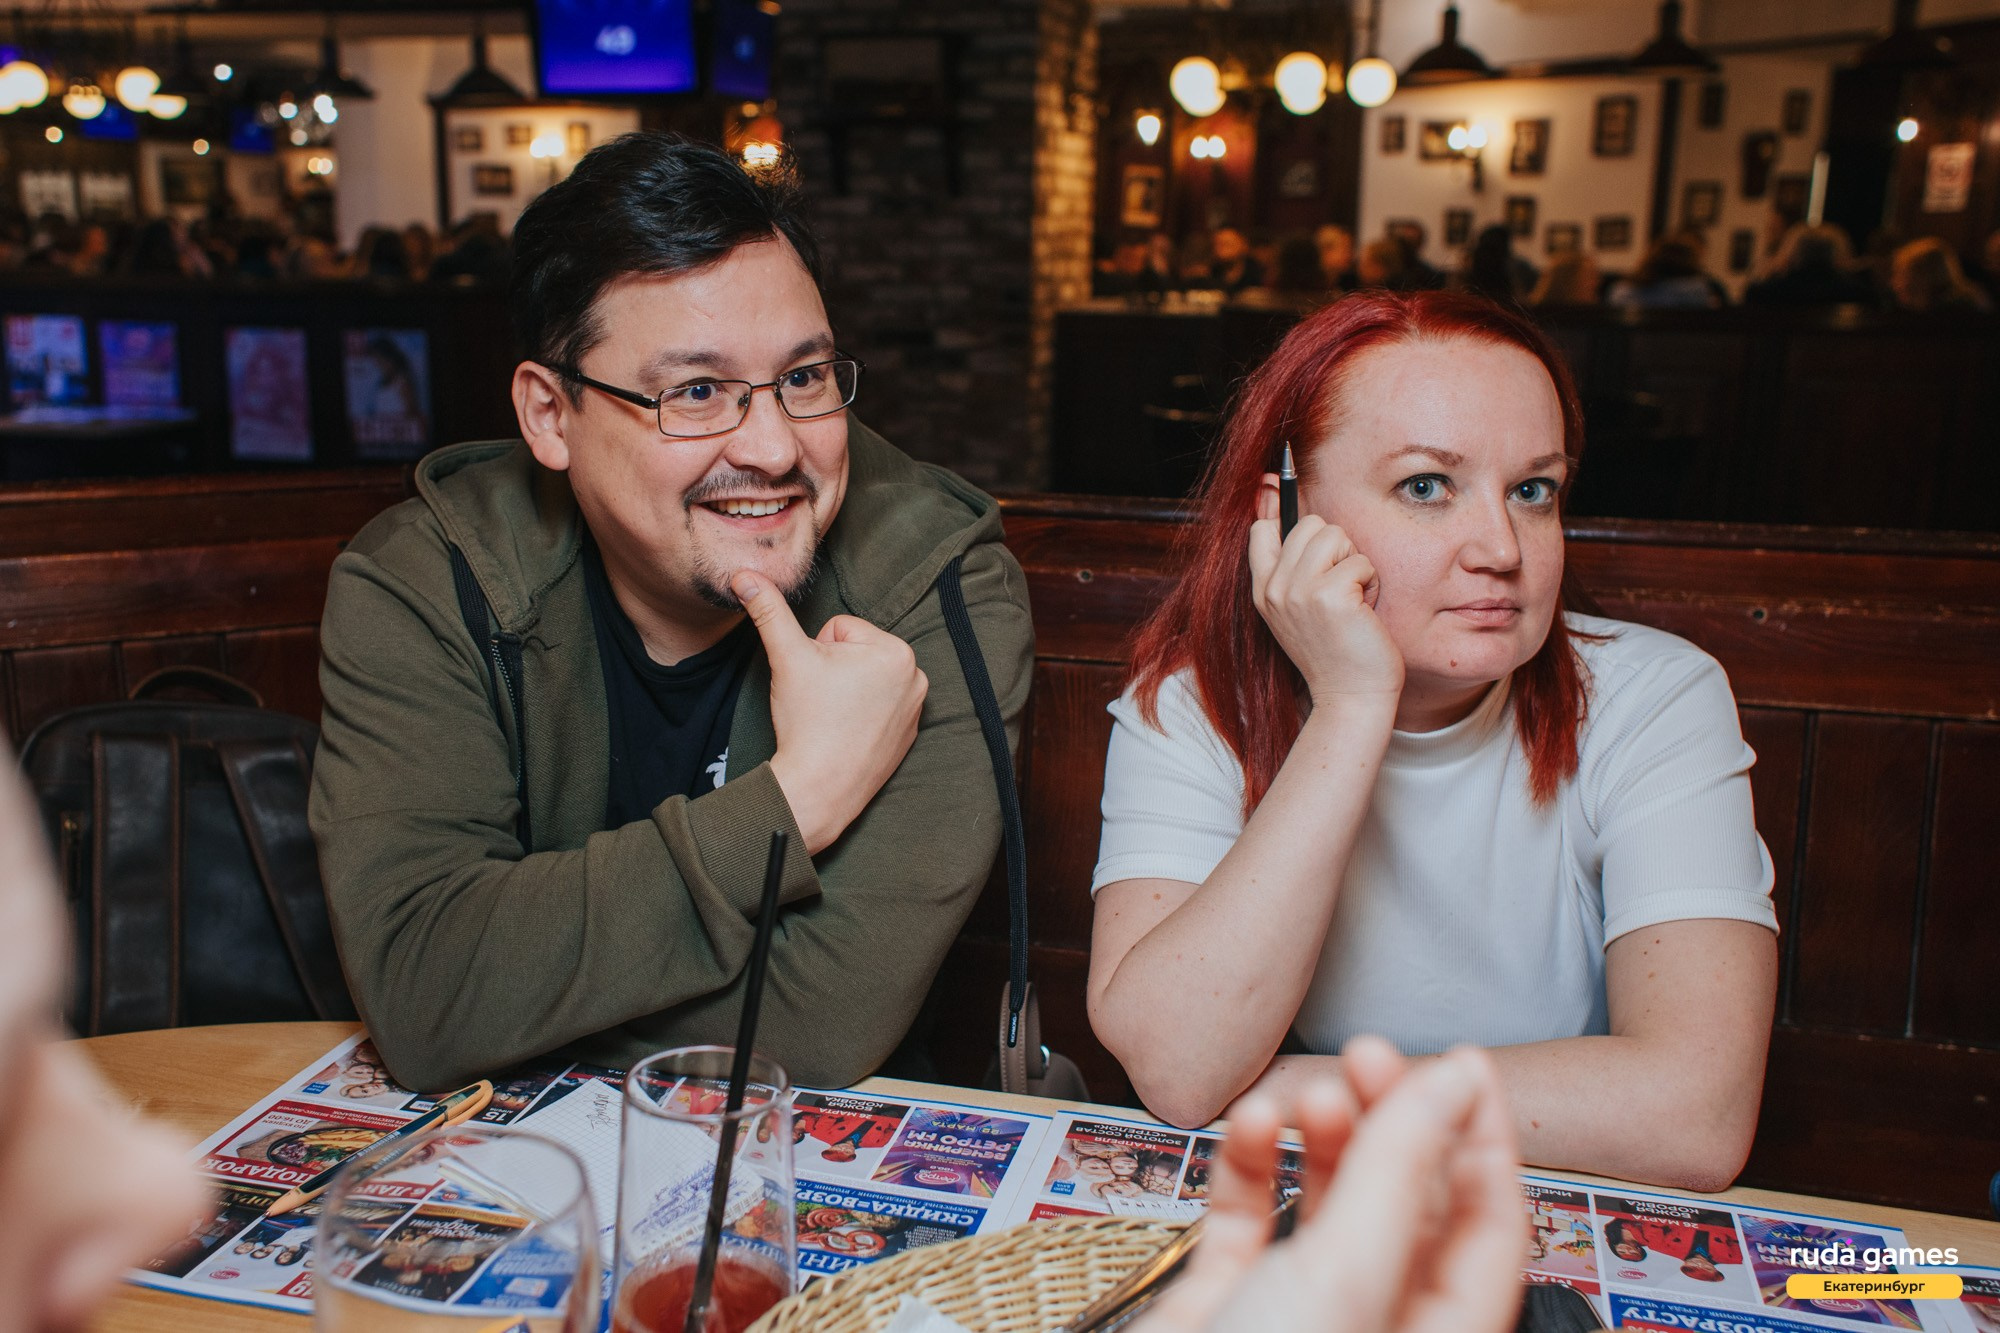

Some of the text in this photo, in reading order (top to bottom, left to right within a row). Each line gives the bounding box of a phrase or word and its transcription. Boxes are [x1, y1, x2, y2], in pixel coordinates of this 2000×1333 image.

[824, 1095, 884, 1108] КОРОВКА
[827, 1101, 874, 1112] БОЖЬЯ
[482, 1111, 507, 1122] 15
[819, 1107, 857, 1117] МАРТА
[931, 1120, 1000, 1135] 22 МАРТА
[1093, 1123, 1167, 1138] «СТРЕЛОК»
[907, 1129, 1012, 1152] РЕТРО FM
[1075, 1126, 1183, 1146] ЗОЛОТОЙ СОСТАВ
[1094, 1136, 1144, 1148] АПРЕЛЯ
[903, 1140, 1008, 1161] ВЕЧЕРИНКА
[813, 1183, 851, 1195] ВТОРНИК
[857, 1191, 917, 1205] ПОНЕДЕЛЬНИК
[922, 1200, 979, 1215] ВОСКРЕСЕНЬЕ
[1624, 1199, 1700, 1215] КОРОВКА
[1635, 1205, 1691, 1219] БОЖЬЯ
[1631, 1213, 1699, 1229] 26 МАРТА
[1617, 1297, 1659, 1309] ЧЕТВЕРГ
[1667, 1304, 1699, 1315] СРЕДА
[1708, 1310, 1756, 1322] ВТОРНИК
